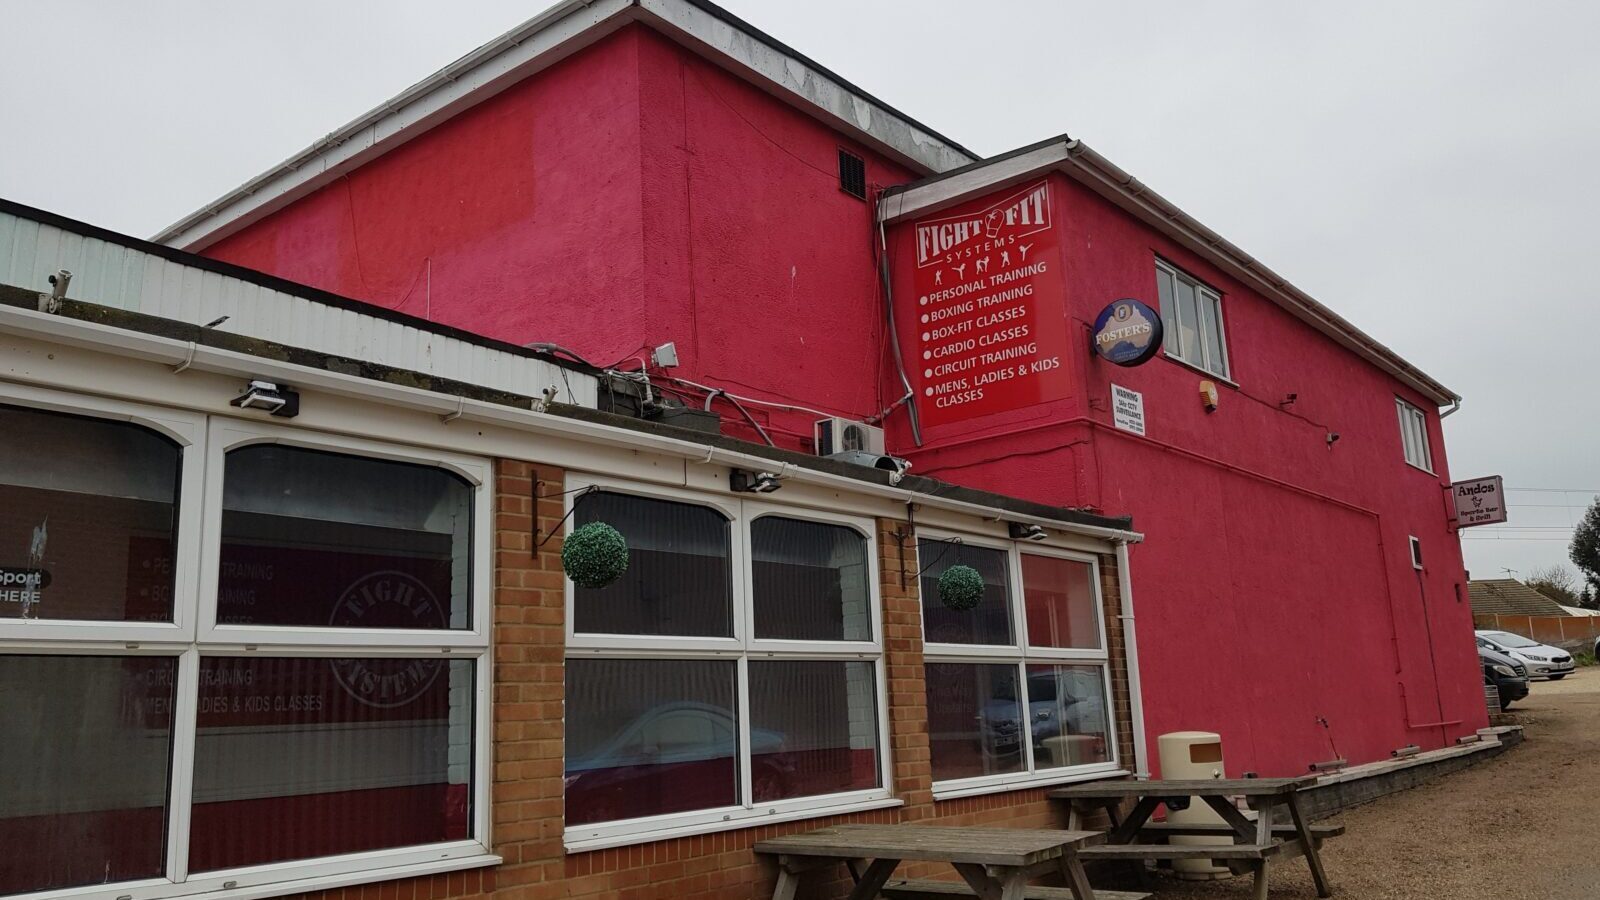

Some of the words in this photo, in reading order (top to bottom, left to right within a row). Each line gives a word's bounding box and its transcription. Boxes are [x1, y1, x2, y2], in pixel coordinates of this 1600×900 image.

[918, 219, 983, 263] FIGHT
[1005, 186, 1046, 226] FIT
[946, 234, 1015, 264] SYSTEMS
[930, 280, 987, 304] PERSONAL
[989, 261, 1047, 287] TRAINING
[931, 302, 974, 323] BOXING
[976, 284, 1034, 309] TRAINING
[932, 320, 973, 341] BOX-FIT
[976, 305, 1026, 328] CLASSES
[1095, 322, 1151, 345] FOSTER'S
[933, 339, 975, 358] CARDIO
[979, 325, 1029, 347] CLASSES
[934, 357, 977, 377] CIRCUIT
[980, 342, 1037, 366] TRAINING
[935, 379, 971, 396] MENS,
[974, 367, 1014, 387] LADIES
[1018, 364, 1028, 376] &
[1031, 357, 1060, 374] KIDS
[936, 389, 984, 408] CLASSES
[1115, 388, 1138, 402] WARNING
[1458, 483, 1495, 496] Andos
[232, 696, 241, 713] &
[245, 695, 270, 713] KIDS
[274, 694, 322, 711] CLASSES
